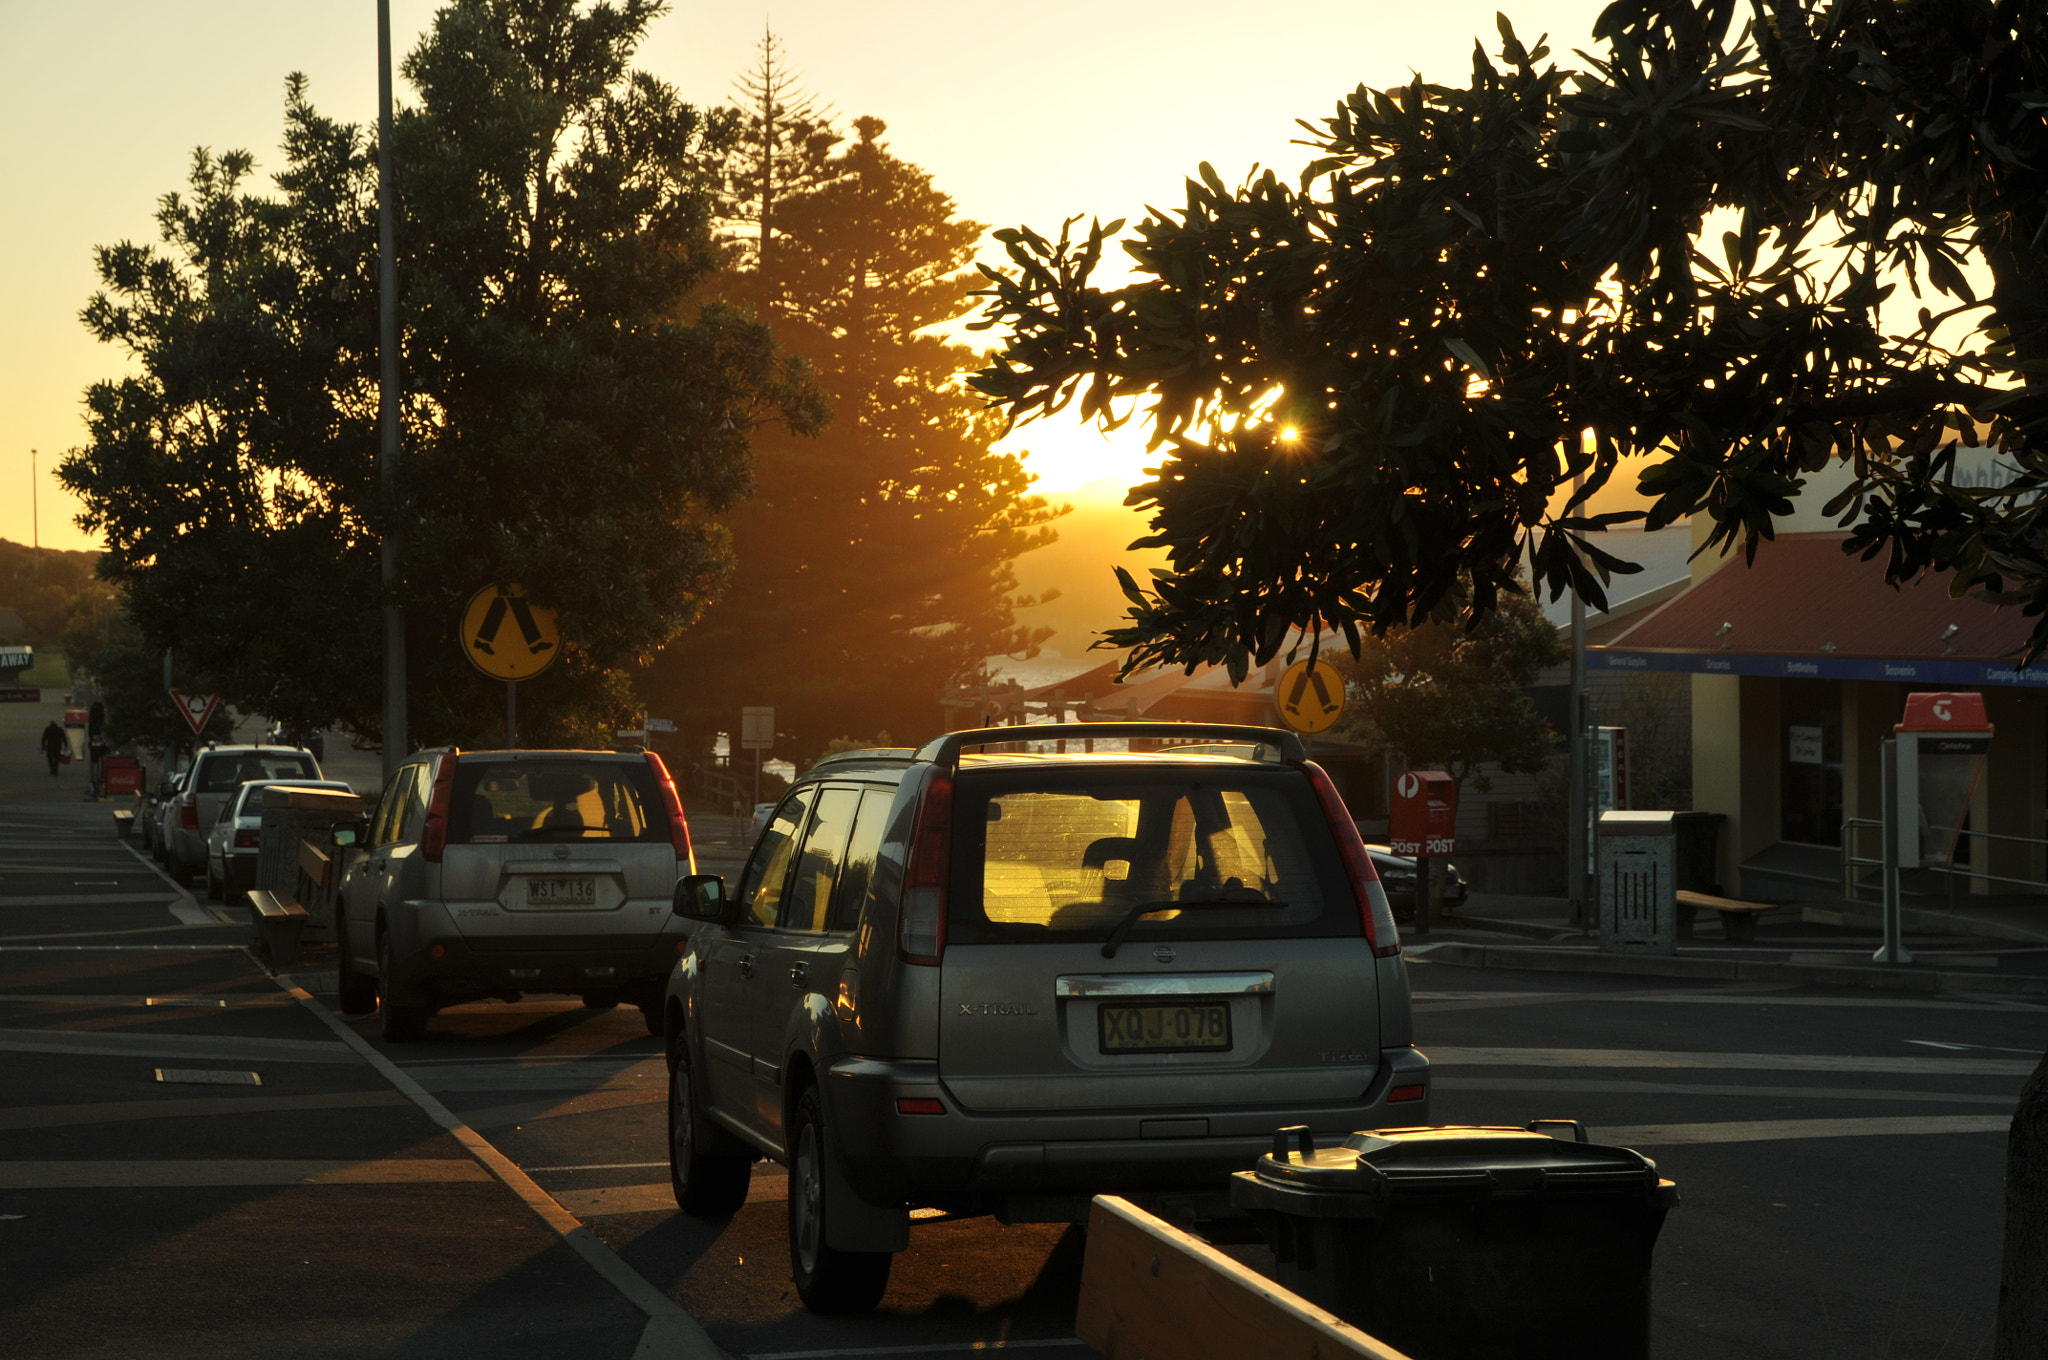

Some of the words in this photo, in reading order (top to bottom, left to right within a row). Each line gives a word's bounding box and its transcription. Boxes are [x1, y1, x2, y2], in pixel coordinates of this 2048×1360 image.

[1, 654, 30, 667] AWAY
[1788, 661, 1818, 674] Bottleshop
[1885, 664, 1916, 677] Souvenirs
[1987, 668, 2018, 683] Camping
[1390, 842, 1421, 854] POST
[1426, 839, 1455, 854] POST
[569, 881, 592, 897] 136
[959, 1004, 1037, 1016] X-TRAIL
